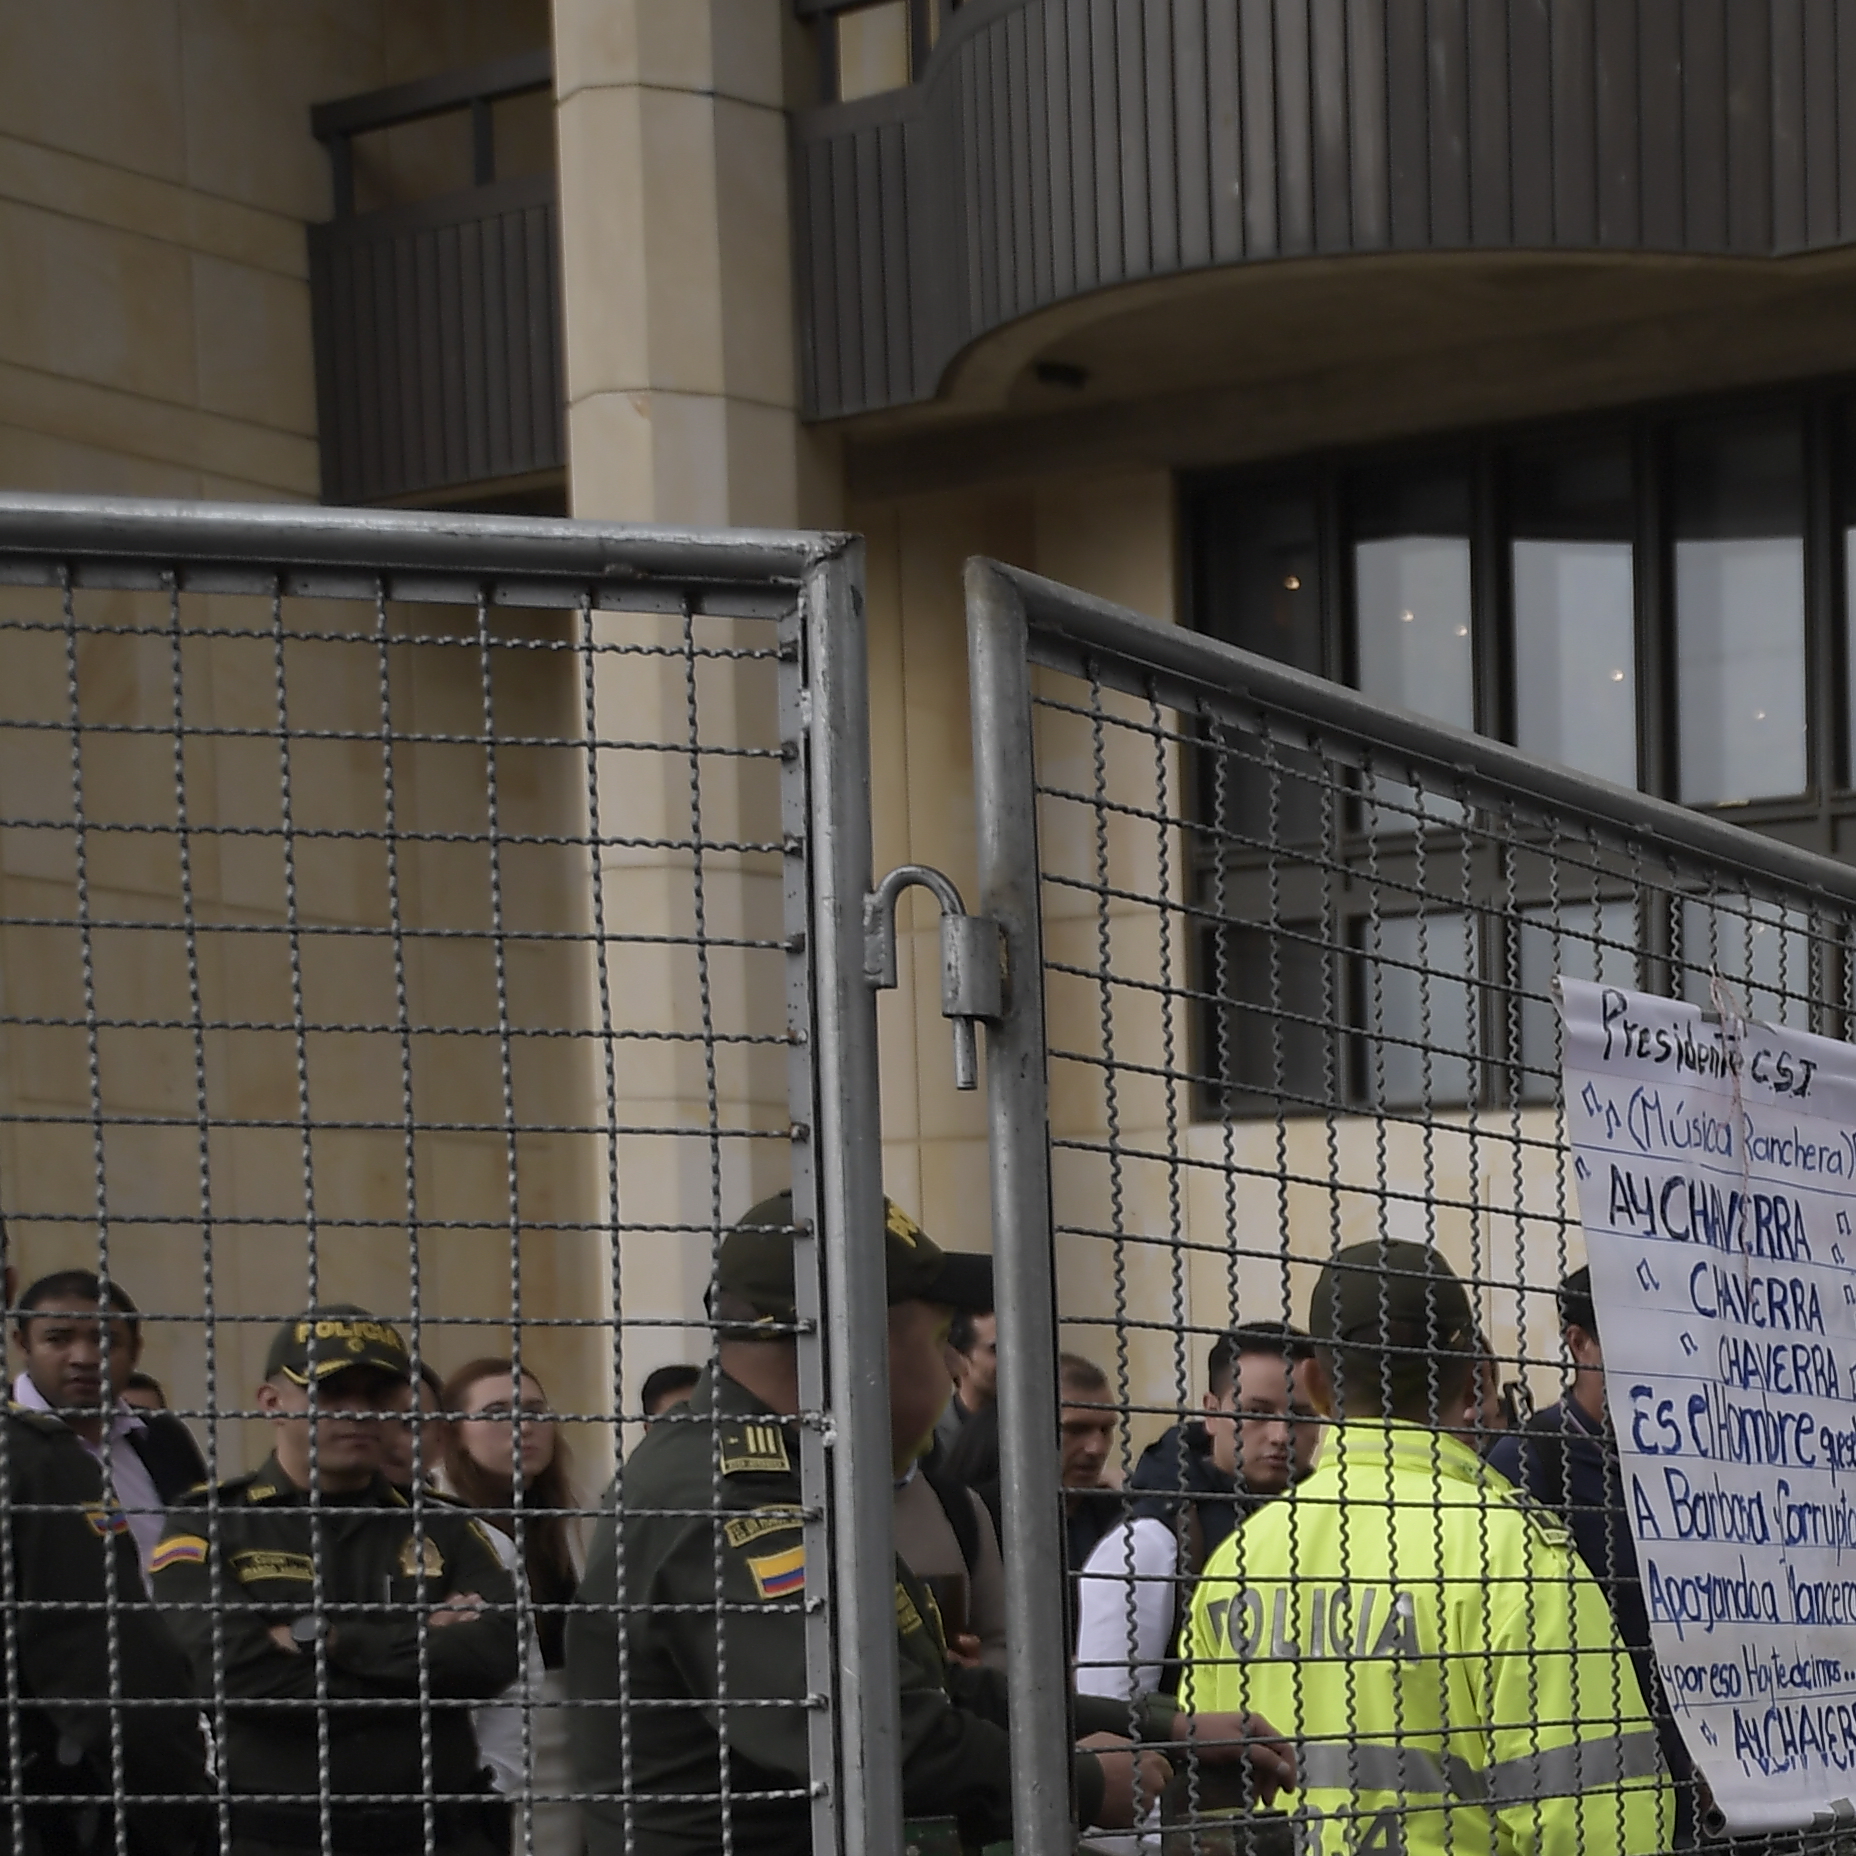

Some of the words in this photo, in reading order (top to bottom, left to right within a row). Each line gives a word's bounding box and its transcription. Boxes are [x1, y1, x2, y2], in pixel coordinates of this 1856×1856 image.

[1690, 1261, 1826, 1336] CHAVERRA
[1719, 1334, 1840, 1399] CHAVERRA
[1713, 1381, 1816, 1468] Hombre
[1632, 1473, 1662, 1540] A
[1206, 1587, 1421, 1666] POLICIA
